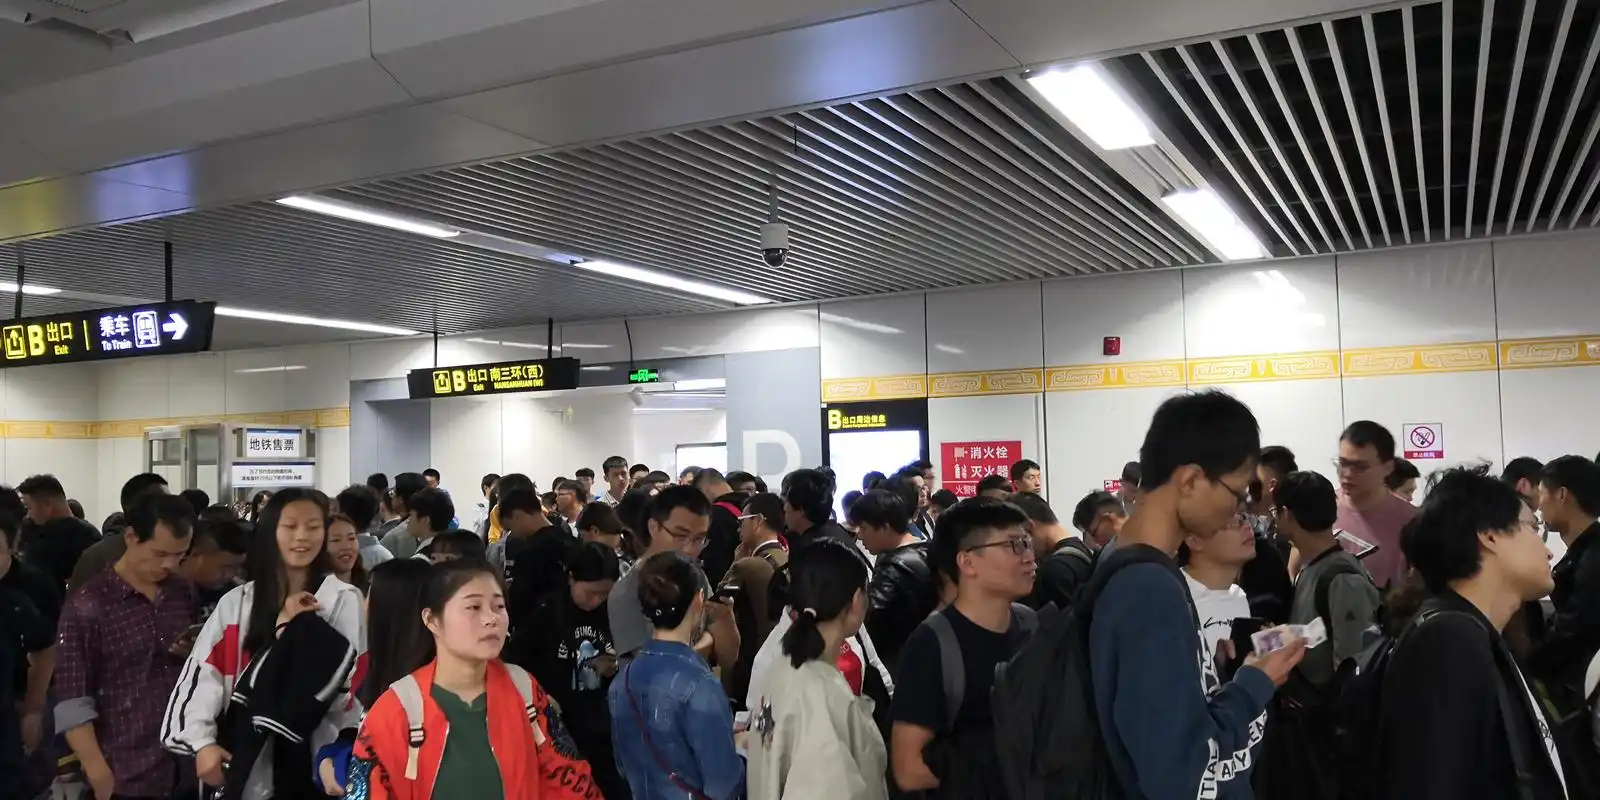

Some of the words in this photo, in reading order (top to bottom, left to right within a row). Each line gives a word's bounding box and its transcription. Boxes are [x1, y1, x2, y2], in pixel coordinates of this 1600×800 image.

[47, 322, 72, 342] 出口
[100, 315, 130, 337] 乘车
[28, 325, 46, 356] B
[102, 341, 112, 350] To
[113, 339, 132, 350] Train
[54, 345, 69, 355] Exit
[452, 370, 466, 392] B
[468, 369, 487, 383] 出口
[490, 364, 544, 382] 南三环(西)
[473, 383, 484, 392] Exit
[828, 409, 842, 430] B
[250, 438, 295, 451] 地铁售票
[970, 445, 1008, 460] 消火栓
[970, 465, 1009, 479] 灭火器
